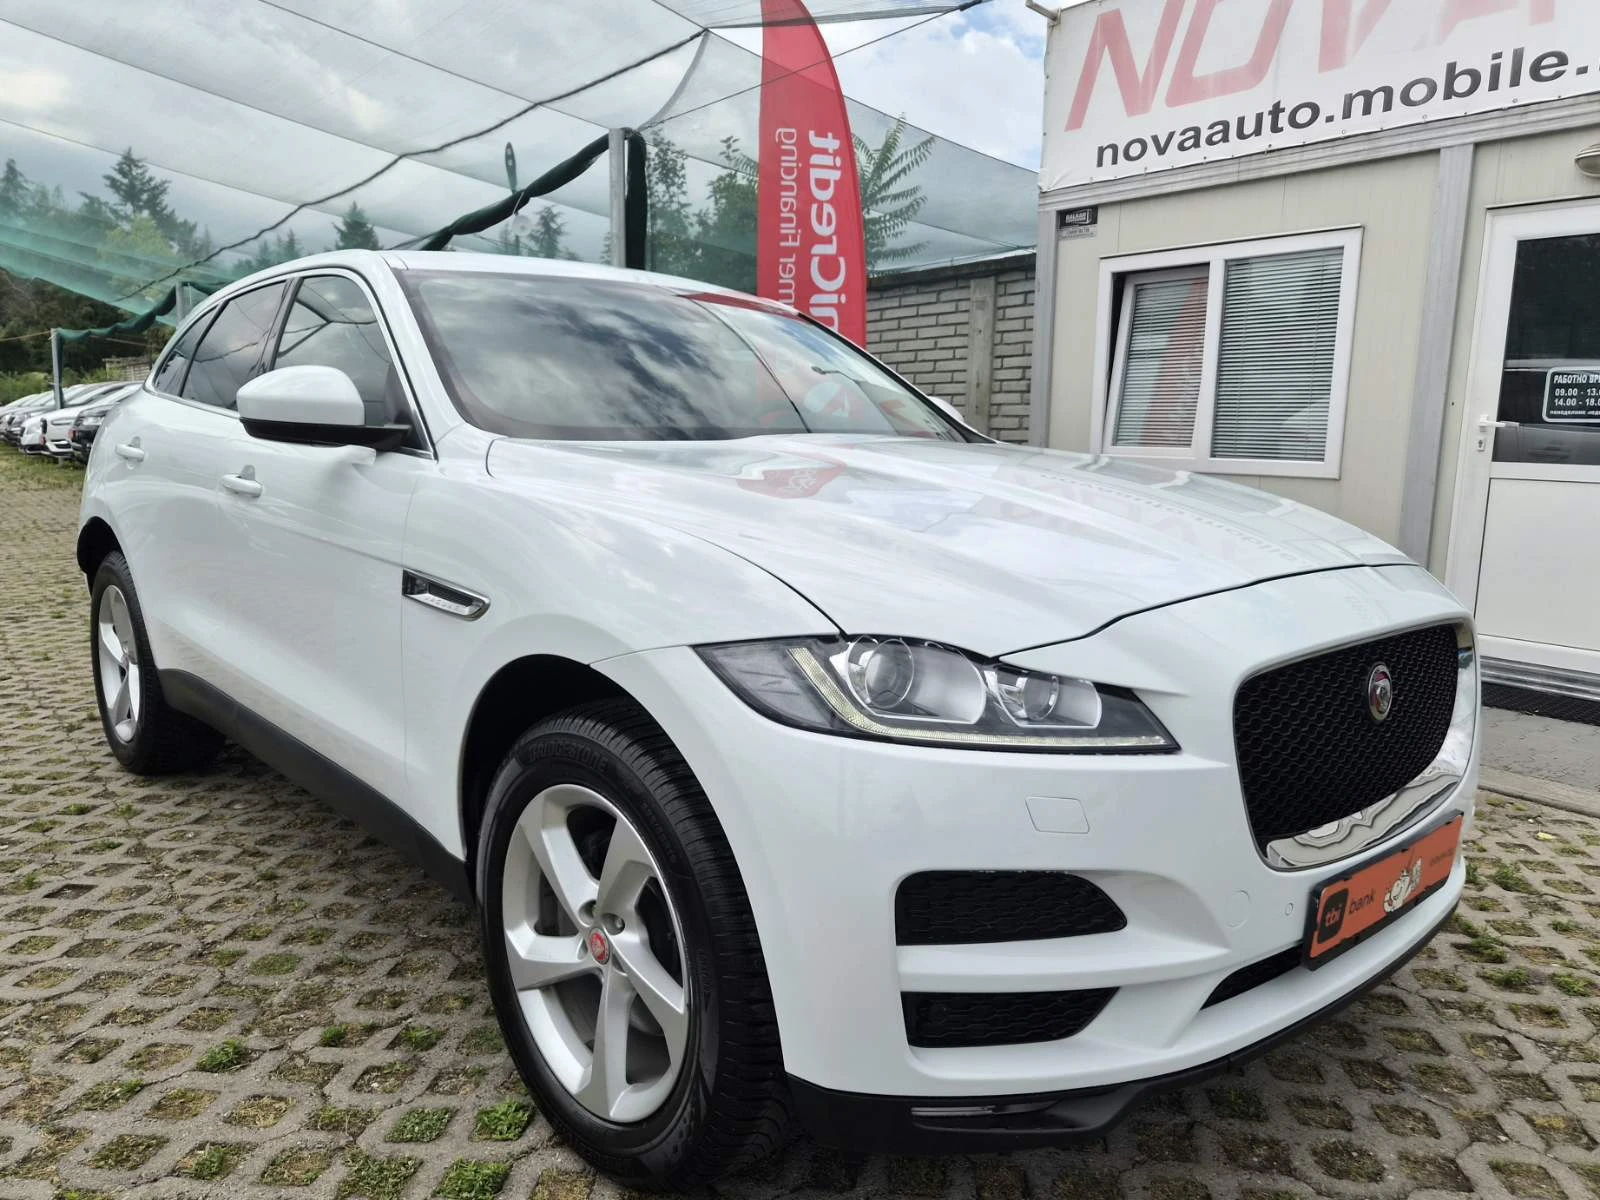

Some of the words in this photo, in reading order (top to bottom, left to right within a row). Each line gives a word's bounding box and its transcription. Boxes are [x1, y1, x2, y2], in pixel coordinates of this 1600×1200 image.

[1064, 0, 1556, 132] NOV
[1096, 45, 1600, 168] novaauto.mobile.
[1553, 374, 1588, 384] РАБОТНО
[1555, 388, 1578, 396] 09.00
[1554, 398, 1577, 406] 14.00
[1349, 888, 1376, 915] bank
